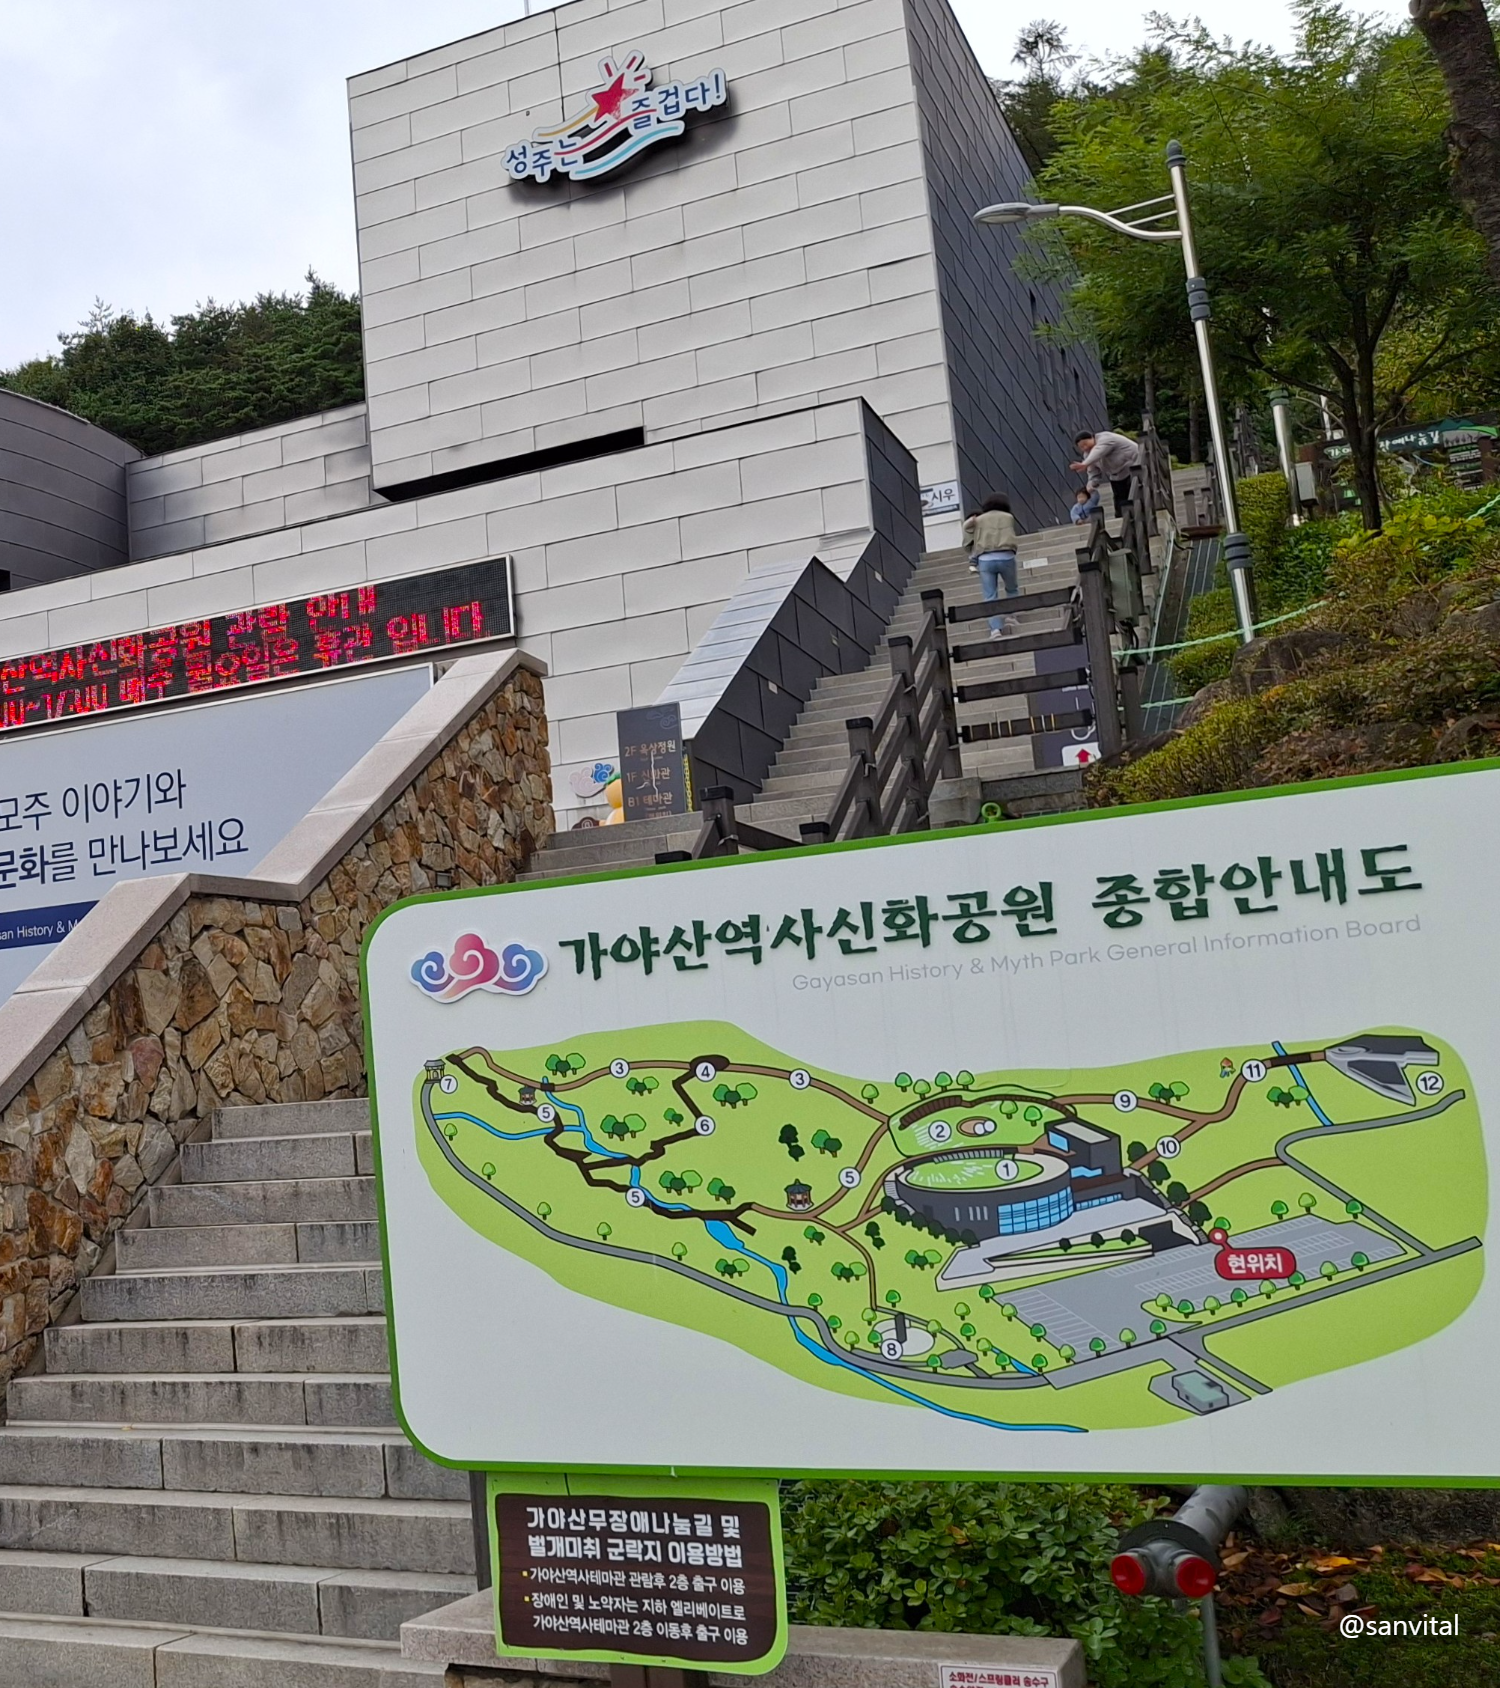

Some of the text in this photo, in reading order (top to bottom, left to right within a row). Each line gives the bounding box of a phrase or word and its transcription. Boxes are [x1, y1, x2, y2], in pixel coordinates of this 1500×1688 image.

[506, 73, 721, 177] 성주는 즐겁다!
[62, 768, 187, 824] 이야기와
[89, 817, 249, 877] 만나보세요
[558, 844, 1423, 980] 가야산역사신화공원 종합안내도
[16, 922, 54, 940] History
[56, 920, 66, 934] &
[792, 914, 1422, 992] Gayasan History & Myth Park General Information Board
[616, 1062, 624, 1074] 3
[702, 1066, 710, 1077] 4
[1246, 1064, 1261, 1077] 11
[445, 1079, 452, 1090] 7
[796, 1073, 804, 1085] 3
[1422, 1076, 1440, 1090] 12
[1120, 1094, 1130, 1108] 9
[543, 1107, 550, 1118] 5
[701, 1119, 709, 1132] 6
[936, 1125, 945, 1138] 2
[1159, 1140, 1177, 1154] 10
[1003, 1164, 1009, 1176] 1
[846, 1171, 854, 1184] 5
[632, 1191, 639, 1203] 5
[1226, 1252, 1284, 1276] 현위치
[887, 1343, 897, 1356] 8
[526, 1507, 741, 1539] 가야산무장애나눔길 및
[528, 1535, 743, 1569] 벌개미취 군락지 이용방법
[529, 1567, 746, 1596] 가야산역사테마관 관람후 2층 출구 이용
[531, 1591, 747, 1621] 장애인 및 노약자는 지하 엘리베이트로
[533, 1614, 749, 1646] 가야산역사테마관 2층 이동후 출구 이용
[1023, 1675, 1049, 1687] 송수구
